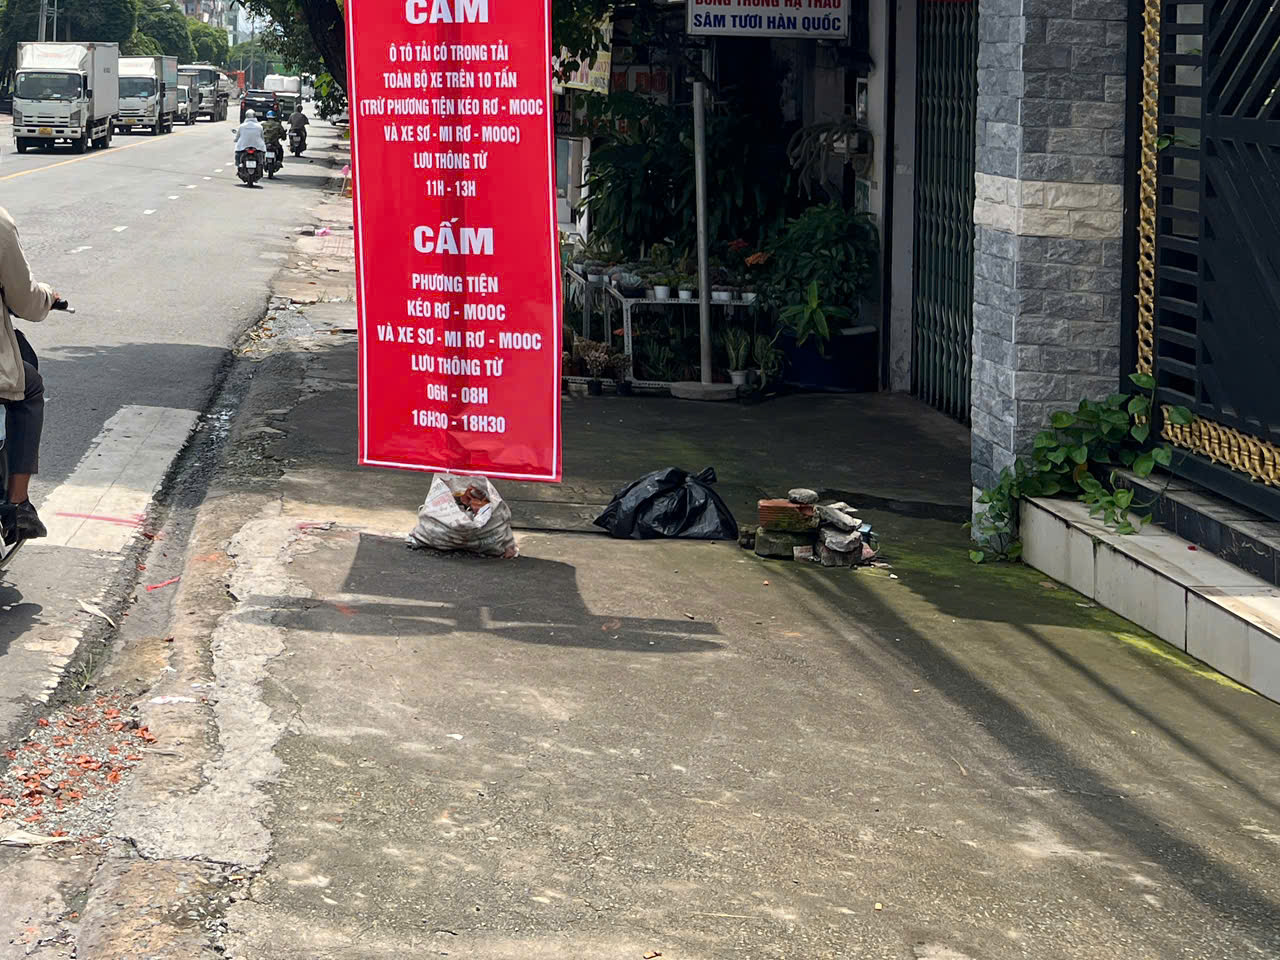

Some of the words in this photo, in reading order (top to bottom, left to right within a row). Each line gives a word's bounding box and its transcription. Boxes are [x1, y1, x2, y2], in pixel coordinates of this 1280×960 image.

[693, 12, 726, 28] SÂM
[730, 14, 762, 29] TƯƠI
[767, 13, 797, 30] HÀN
[802, 12, 841, 31] QUỐC
[389, 43, 397, 62] Ô
[400, 43, 412, 62] TÔ
[415, 40, 431, 61] TẢI
[433, 42, 447, 61] CÓ
[451, 45, 487, 64] TRỌNG
[490, 39, 508, 60] TẢI
[383, 70, 411, 88] TOÀN
[414, 69, 428, 91] BỘ
[430, 72, 442, 88] XE
[445, 69, 474, 88] TRÊN
[478, 72, 491, 88] 10
[494, 66, 517, 88] TẤN
[360, 96, 385, 116] (TRỪ
[387, 98, 429, 115] PHƯƠNG
[432, 96, 454, 118] TIỆN
[458, 96, 480, 115] KÉO
[483, 98, 498, 115] RƠ
[509, 99, 543, 116] MOOC
[384, 122, 398, 142] VÀ
[401, 125, 414, 142] XE
[417, 124, 430, 142] SƠ
[439, 126, 452, 142] MI
[456, 124, 471, 142] RƠ
[482, 125, 520, 144] MOOC)
[414, 152, 432, 169] LƯU
[435, 150, 470, 169] THÔNG
[472, 150, 488, 169] TỪ
[426, 180, 444, 196] 11H
[455, 180, 476, 197] 13H
[414, 217, 494, 255] CẤM
[412, 273, 463, 292] PHƯƠNG
[467, 273, 498, 296] TIỆN
[407, 297, 431, 318] KÉO
[434, 300, 450, 319] RƠ
[464, 303, 506, 320] MOOC
[377, 322, 395, 342] VÀ
[398, 327, 414, 343] XE
[417, 327, 434, 345] SƠ
[445, 331, 461, 347] MI
[466, 330, 485, 348] RƠ
[499, 332, 542, 350] MOOC
[411, 354, 434, 372] LƯU
[437, 354, 480, 376] THÔNG
[484, 356, 504, 376] TỪ
[427, 384, 448, 402] 06H
[461, 387, 488, 404] 08H
[412, 409, 448, 430] 16H30
[461, 414, 506, 433] 18H30
